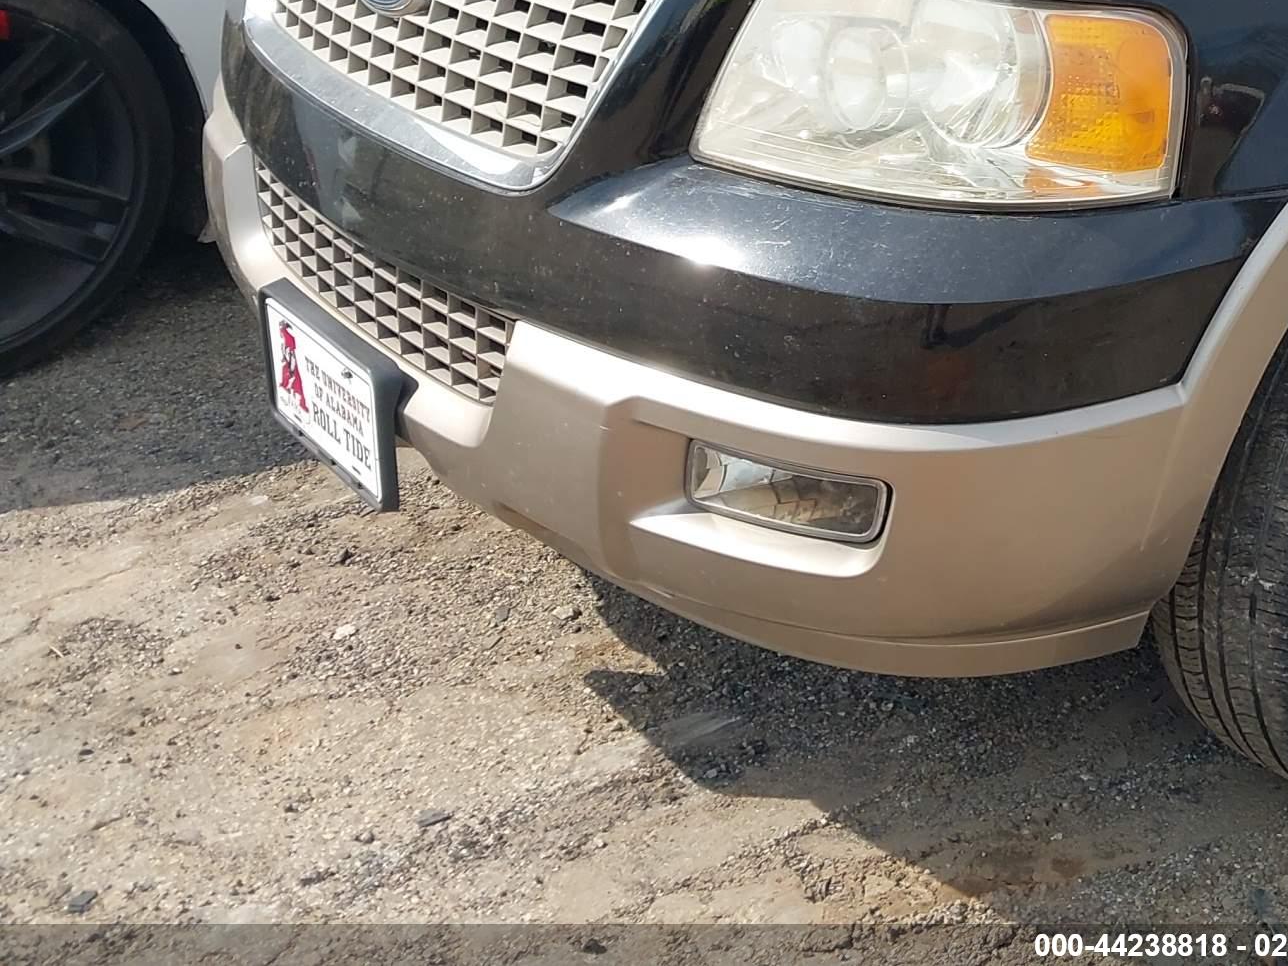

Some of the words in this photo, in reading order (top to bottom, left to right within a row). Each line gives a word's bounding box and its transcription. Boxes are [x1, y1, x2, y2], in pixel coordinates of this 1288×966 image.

[304, 355, 321, 381] THE
[320, 369, 370, 424] UNIVERSITY
[314, 382, 324, 402] OF
[325, 394, 364, 437] ALABAMA
[312, 400, 342, 445] ROLL
[342, 428, 372, 472] TIDE
